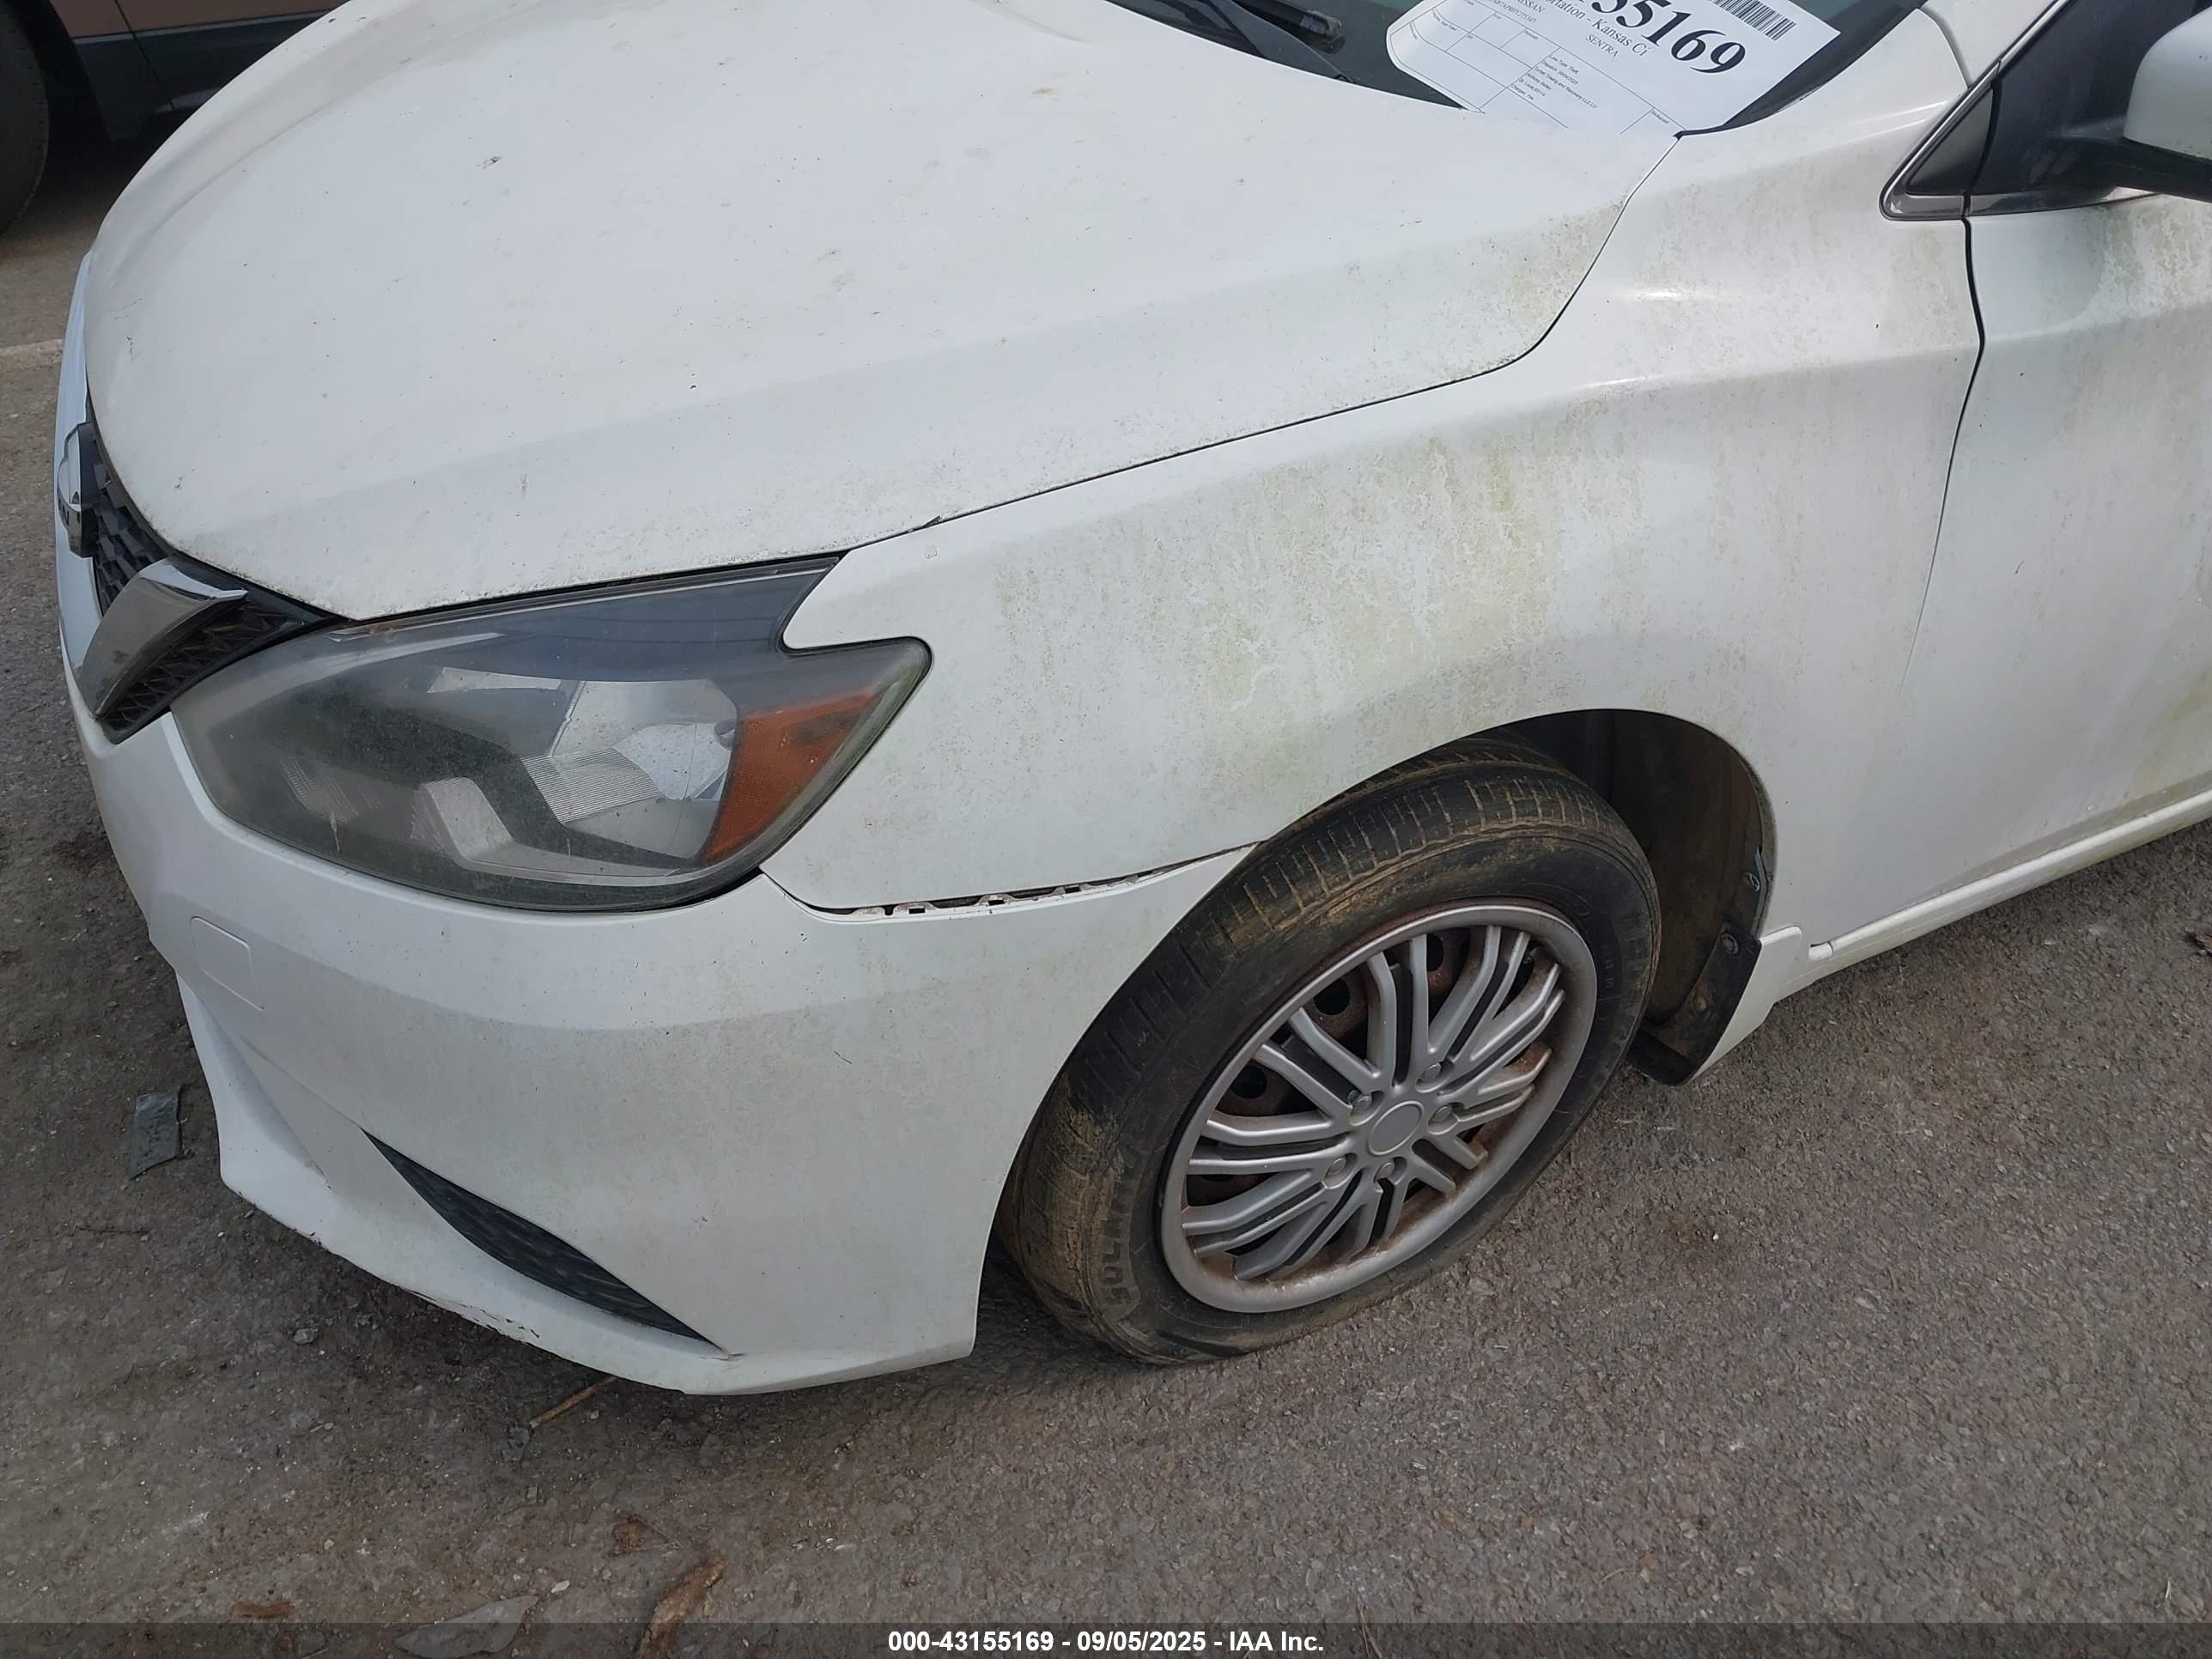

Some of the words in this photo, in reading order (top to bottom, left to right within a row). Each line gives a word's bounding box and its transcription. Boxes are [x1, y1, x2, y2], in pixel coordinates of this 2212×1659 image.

[1586, 33, 1620, 57] SENTRA
[1592, 19, 1632, 46] Kansas
[1632, 42, 1650, 57] Ci
